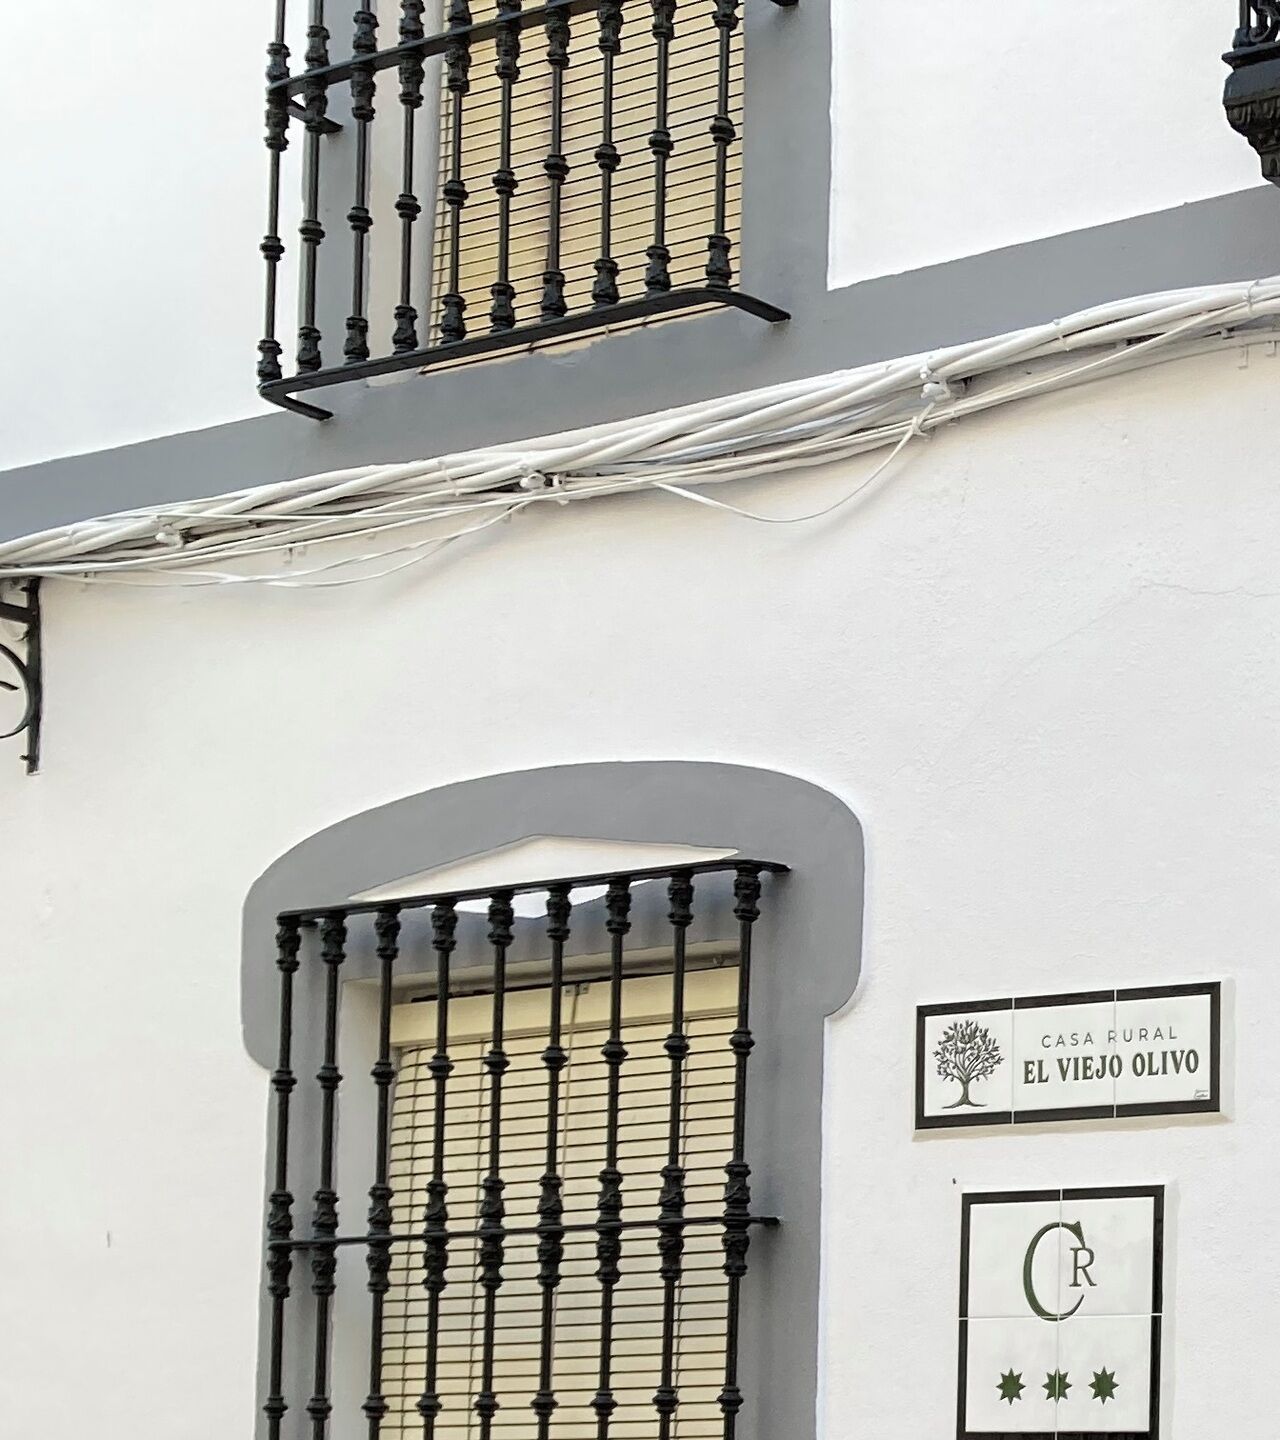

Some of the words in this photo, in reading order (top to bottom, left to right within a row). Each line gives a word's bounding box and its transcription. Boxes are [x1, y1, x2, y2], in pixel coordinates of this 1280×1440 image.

[1041, 1032, 1094, 1049] CASA
[1107, 1025, 1178, 1043] RURAL
[1023, 1059, 1050, 1084] EL
[1056, 1053, 1123, 1082] VIEJO
[1132, 1049, 1199, 1077] OLIVO
